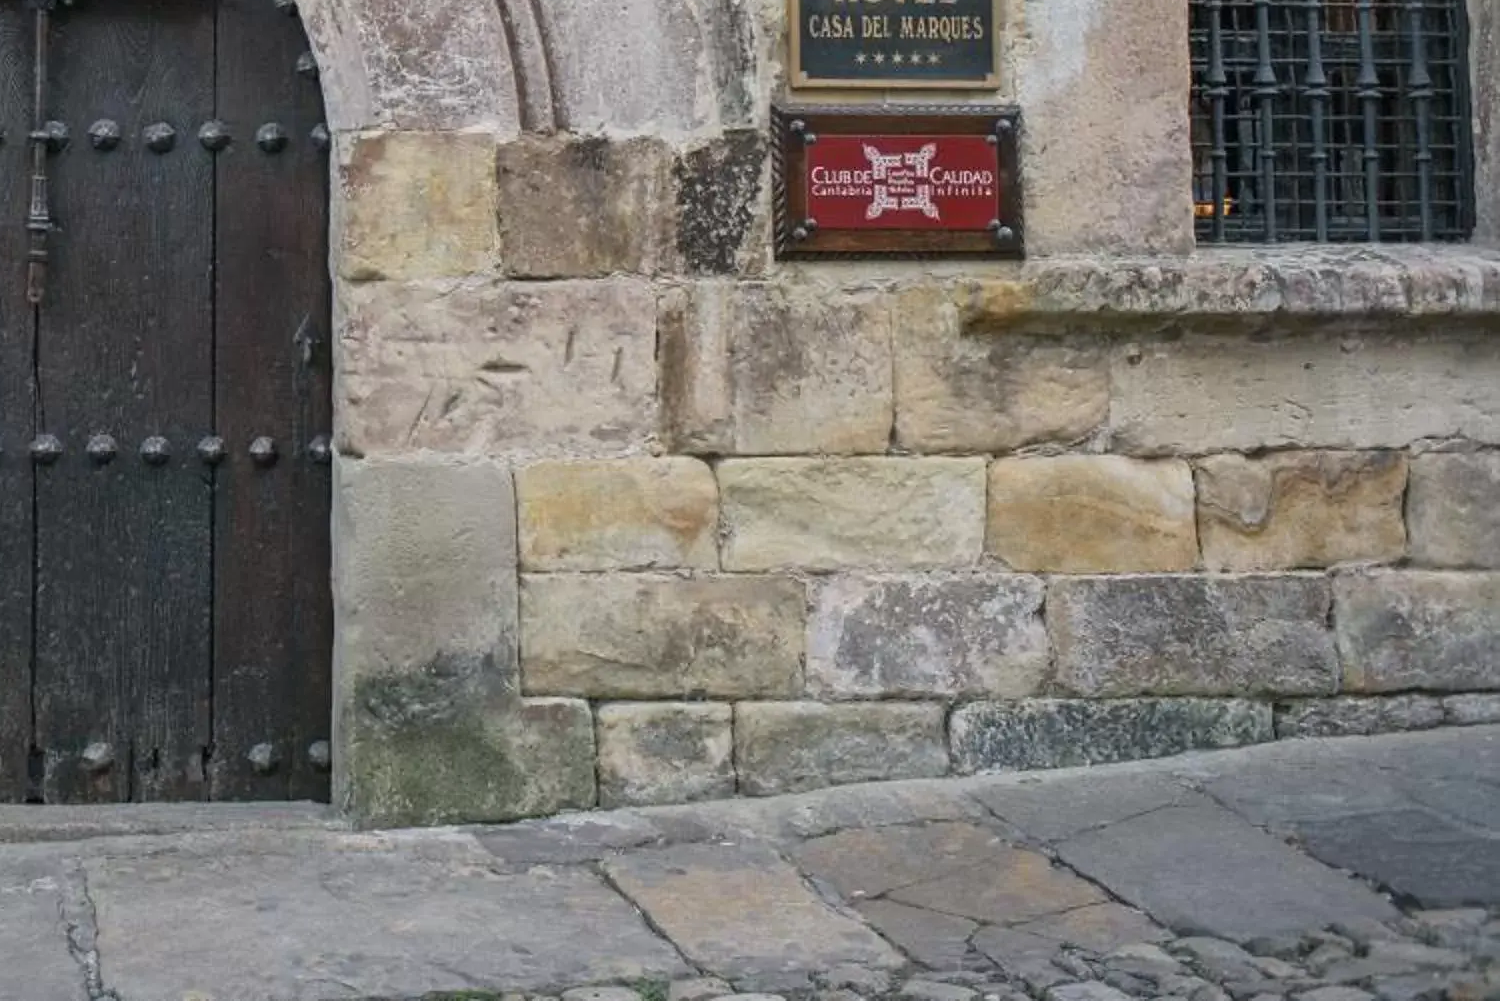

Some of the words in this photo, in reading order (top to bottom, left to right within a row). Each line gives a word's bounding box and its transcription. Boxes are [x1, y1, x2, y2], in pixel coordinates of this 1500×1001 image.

[808, 14, 854, 39] CASA
[862, 15, 891, 39] DEL
[900, 16, 984, 43] MARQUES
[811, 166, 851, 184] CLUB
[852, 170, 873, 184] DE
[929, 166, 993, 185] CALIDAD
[811, 184, 873, 197] Cantabria
